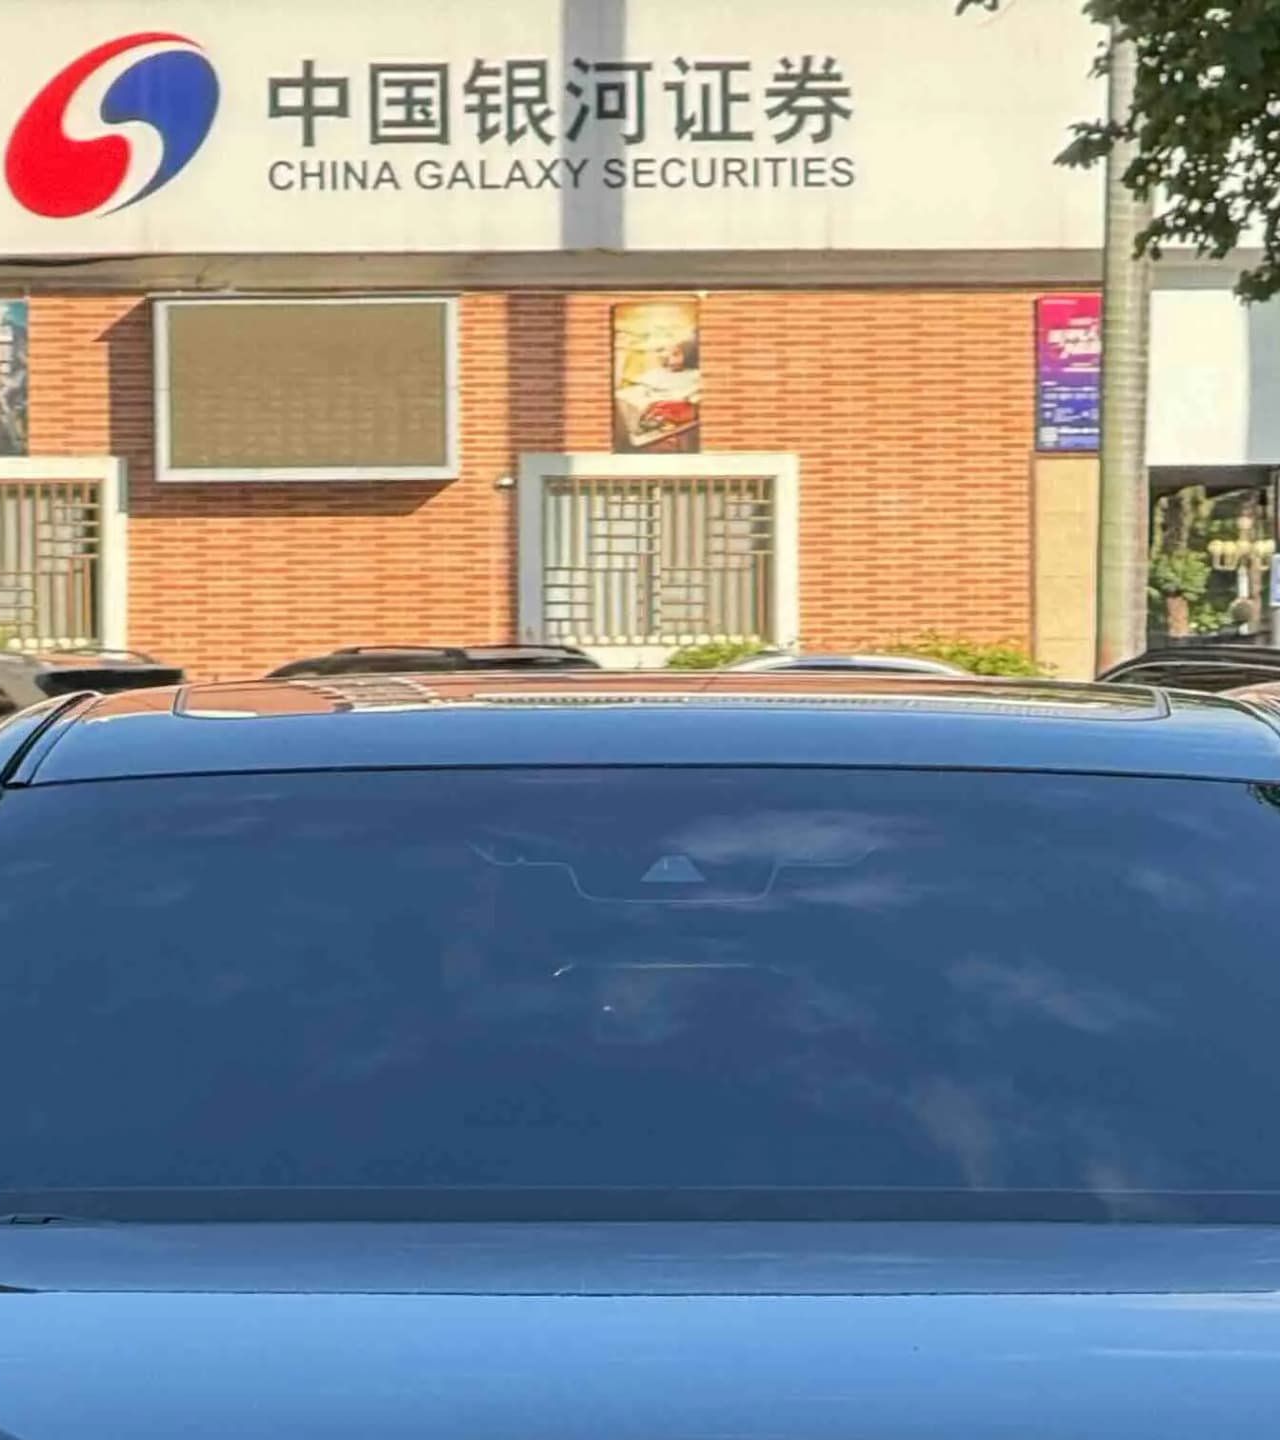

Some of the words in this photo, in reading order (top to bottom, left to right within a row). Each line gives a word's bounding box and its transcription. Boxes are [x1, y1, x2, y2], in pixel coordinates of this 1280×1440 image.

[267, 55, 853, 148] 中国银河证券
[268, 159, 401, 191] CHINA
[414, 157, 589, 191] GALAXY
[603, 156, 856, 190] SECURITIES
